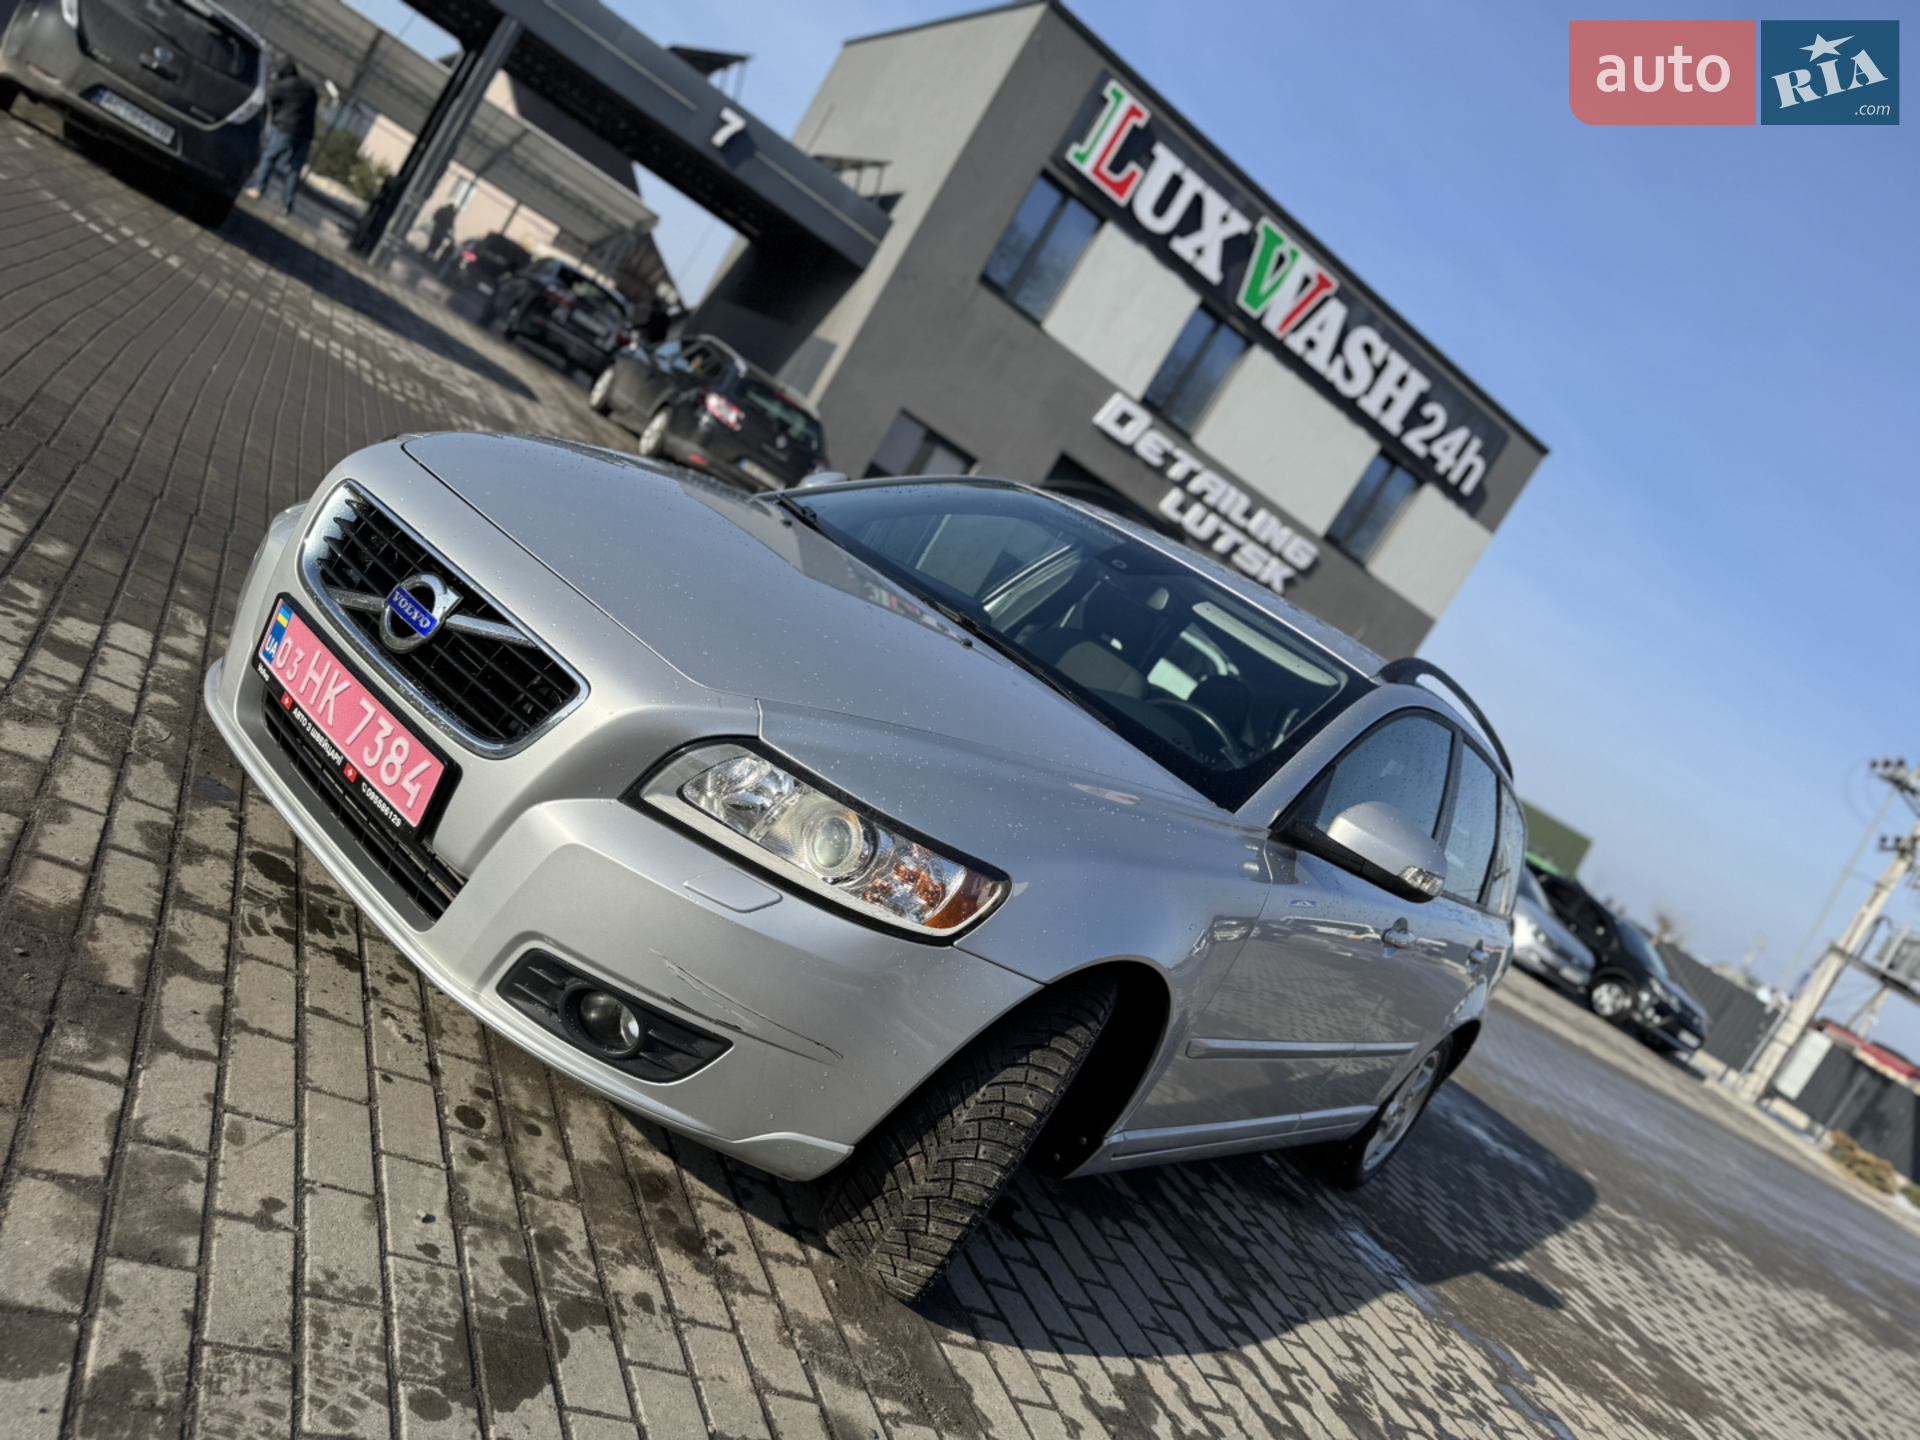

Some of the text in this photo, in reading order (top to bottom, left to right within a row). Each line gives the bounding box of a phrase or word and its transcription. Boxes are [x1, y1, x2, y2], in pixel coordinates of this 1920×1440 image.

[711, 106, 747, 148] 7
[1065, 80, 1487, 496] LUX WASH 24h
[1092, 392, 1319, 571] DETAILING
[1159, 487, 1296, 595] LUTSK
[265, 634, 278, 658] UA
[391, 590, 431, 629] VOLVO
[345, 697, 432, 809] 7384
